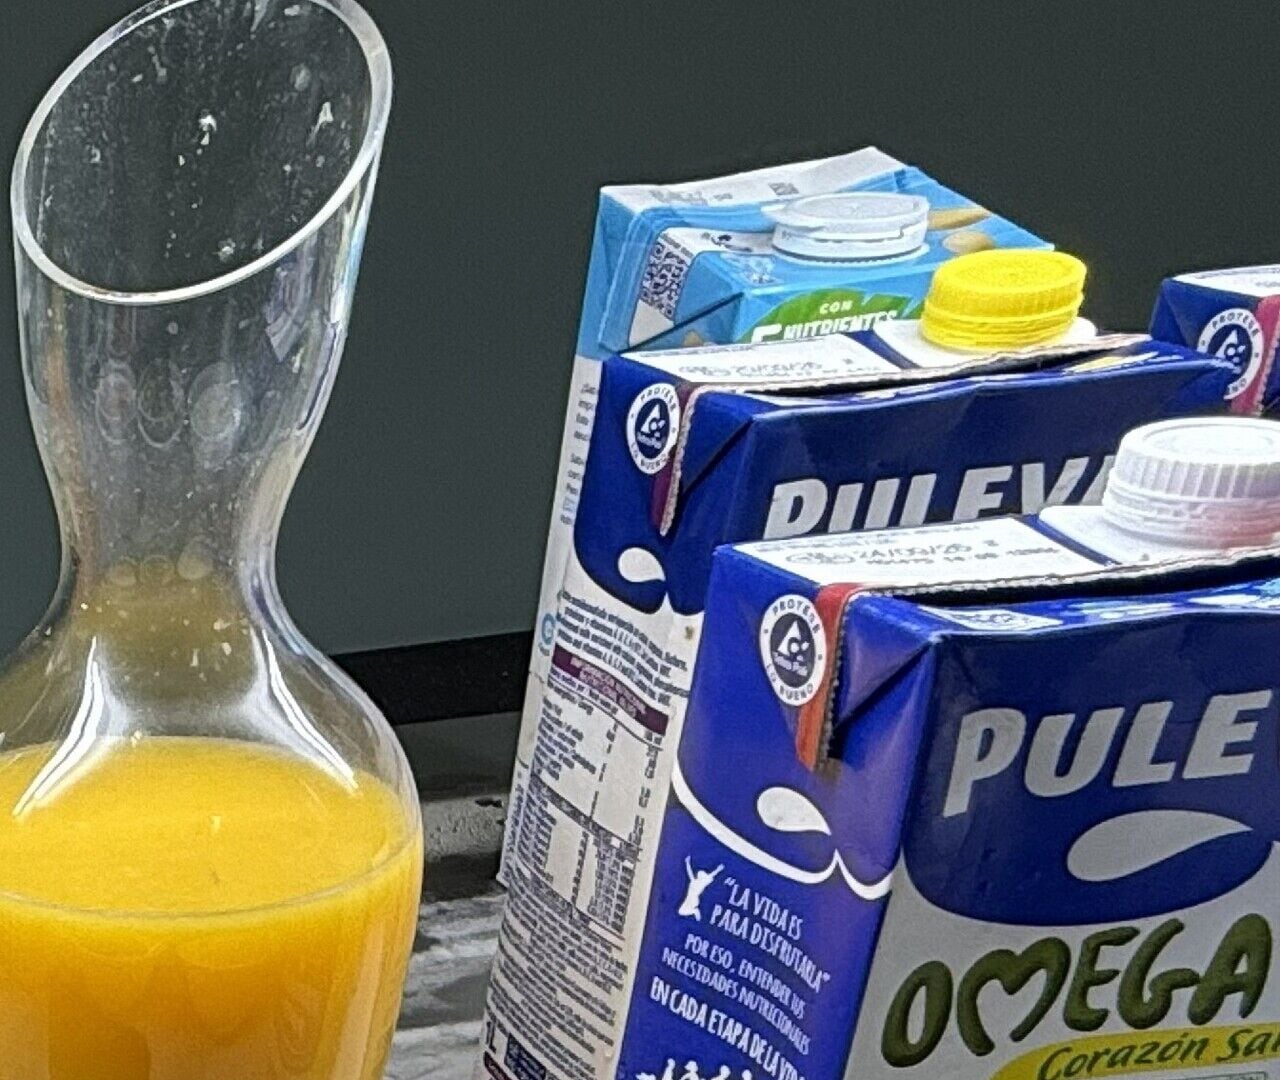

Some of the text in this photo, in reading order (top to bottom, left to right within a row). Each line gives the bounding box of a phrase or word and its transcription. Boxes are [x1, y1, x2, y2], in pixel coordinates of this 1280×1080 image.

[820, 300, 853, 315] CON
[710, 904, 748, 940] PARA
[754, 892, 788, 932] VIDA
[787, 915, 803, 941] ES
[685, 933, 709, 959] POR
[662, 947, 811, 1055] NECESIDADES NUTRICIONALES
[880, 912, 1273, 1067] OMEGA
[650, 976, 670, 1005] EN
[669, 989, 708, 1028] CADA
[708, 1009, 751, 1053] ETAPA
[749, 1032, 767, 1065] DE
[763, 1044, 780, 1078] LA
